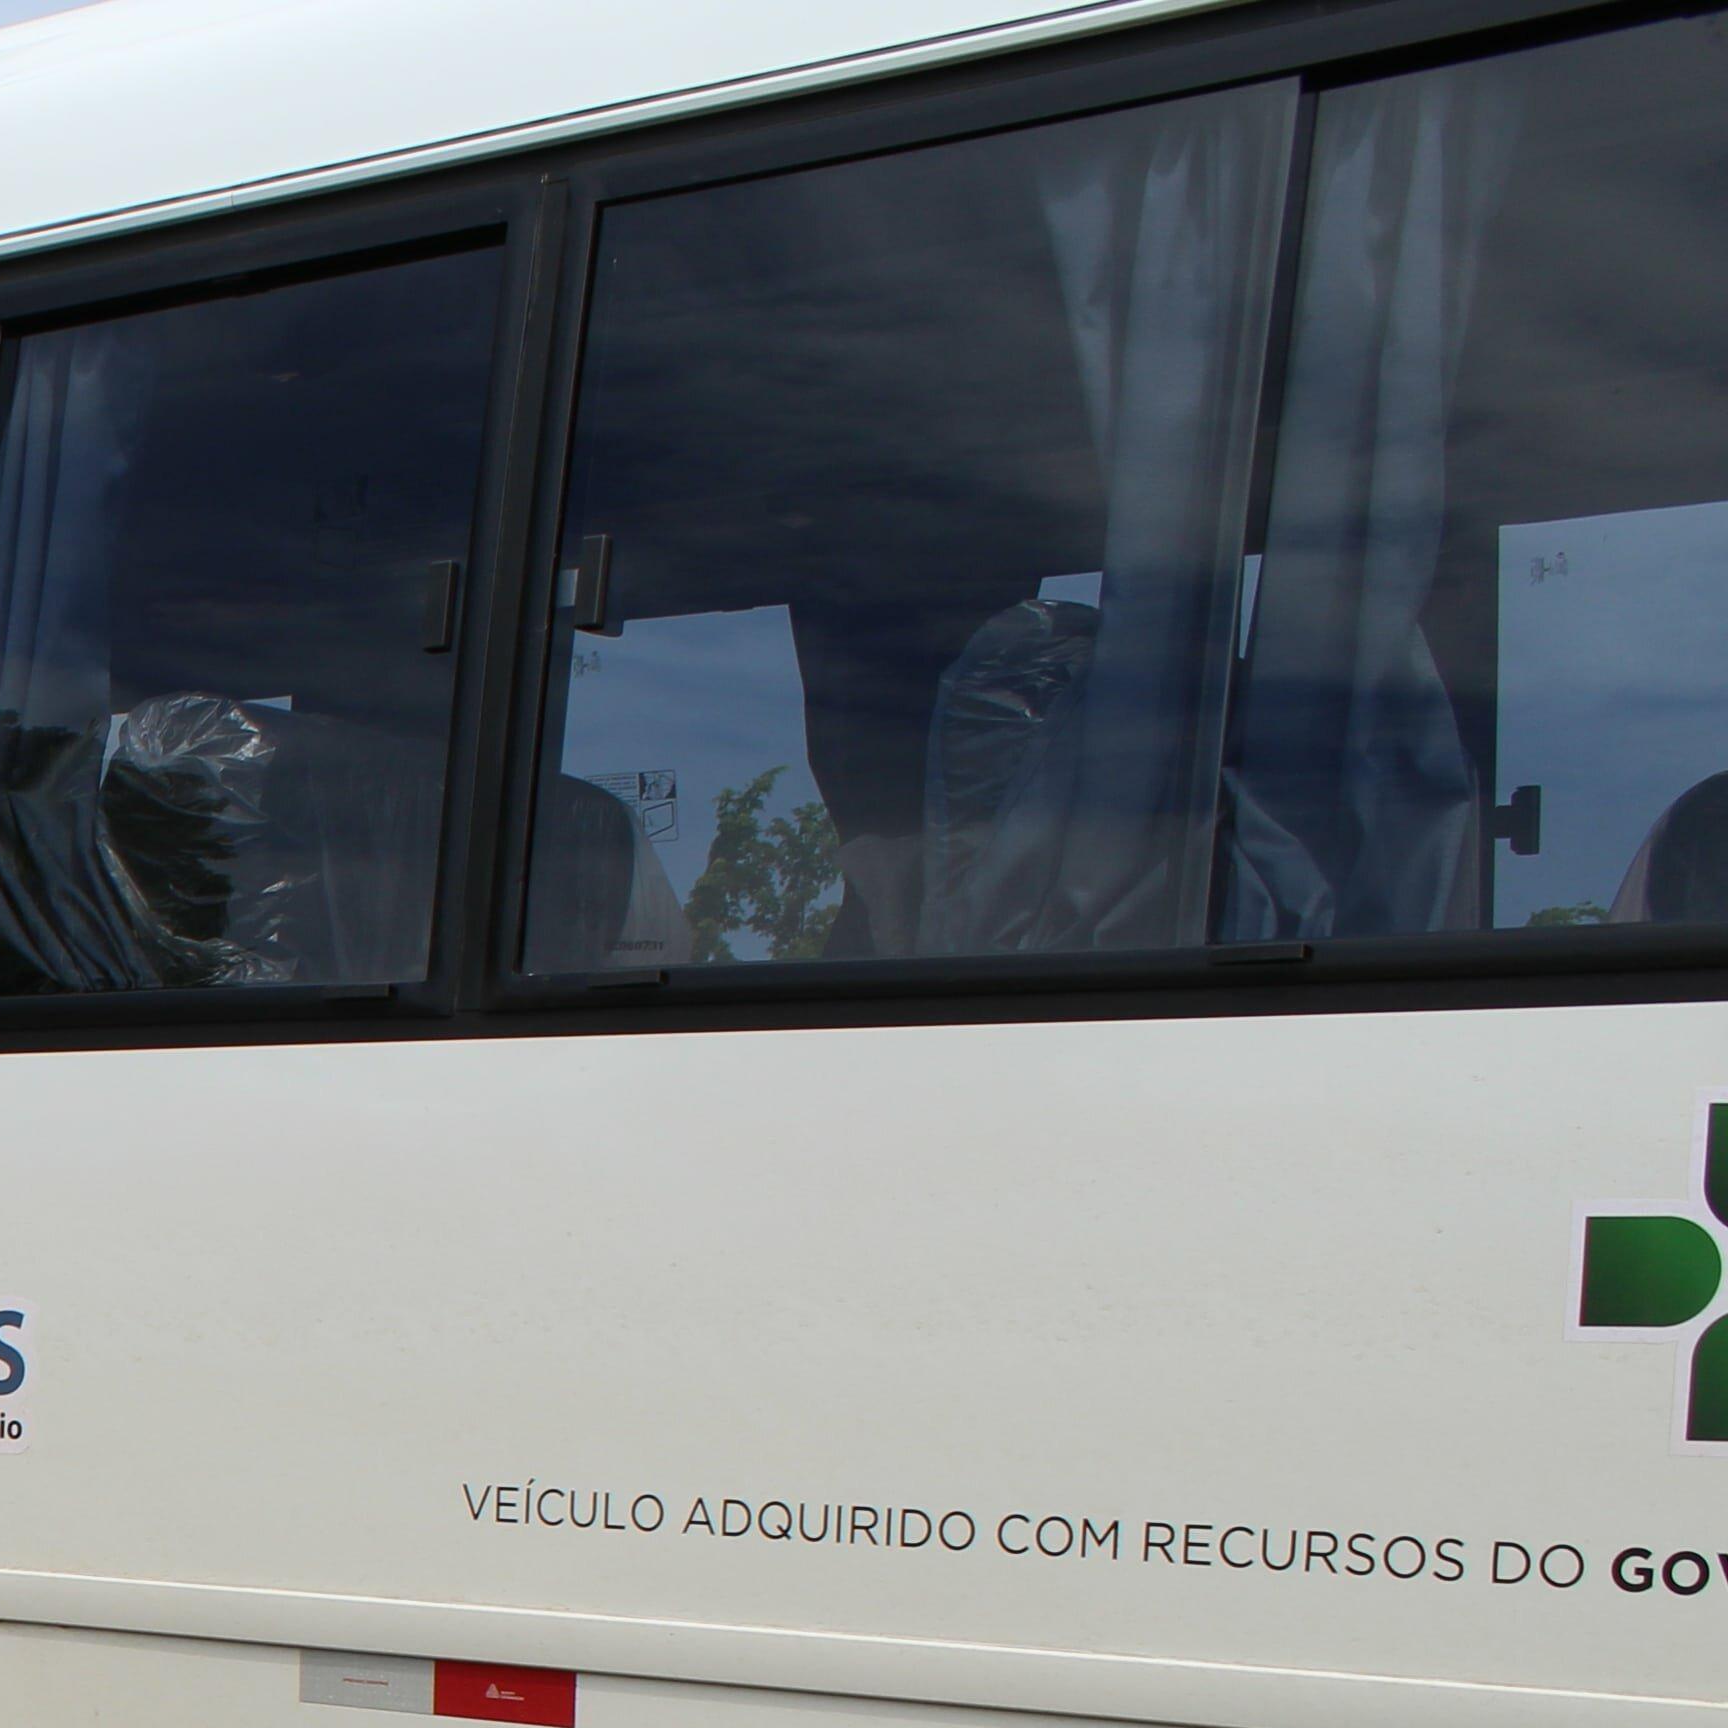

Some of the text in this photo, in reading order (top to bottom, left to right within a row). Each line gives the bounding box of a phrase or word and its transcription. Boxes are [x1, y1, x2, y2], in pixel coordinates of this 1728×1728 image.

[462, 1477, 1728, 1597] VEÍCULO ADQUIRIDO COM RECURSOS DO GO
